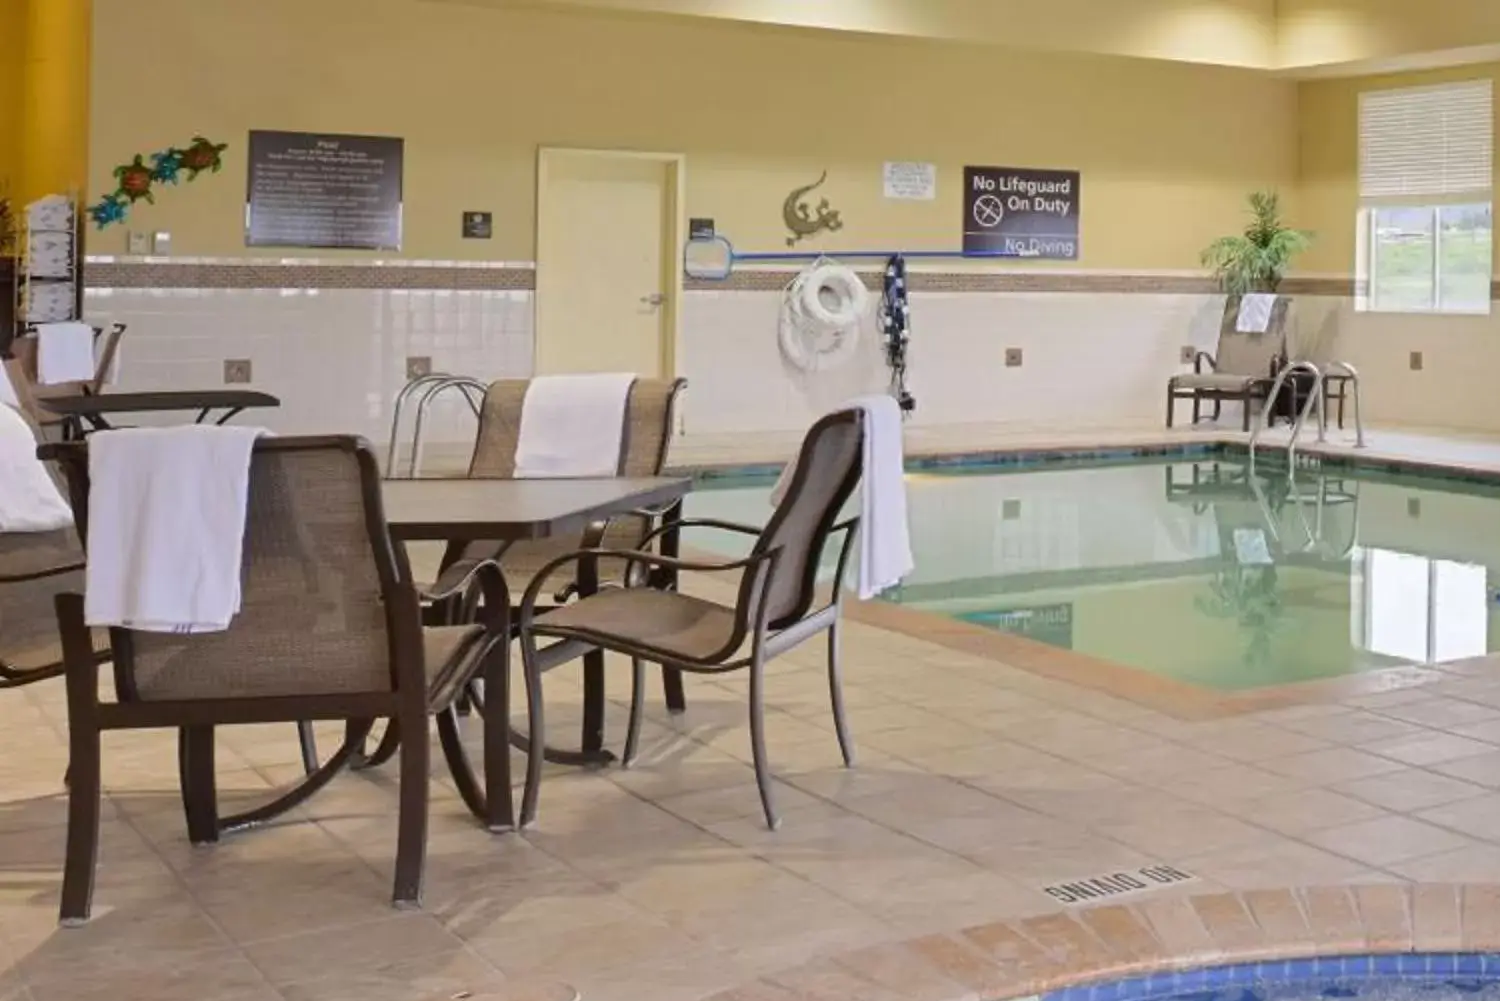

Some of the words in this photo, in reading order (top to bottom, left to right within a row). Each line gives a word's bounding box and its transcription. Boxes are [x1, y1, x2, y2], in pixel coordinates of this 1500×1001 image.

[973, 175, 995, 190] No
[999, 176, 1071, 196] Lifeguard
[1008, 195, 1029, 211] On
[1034, 197, 1070, 217] Duty
[1005, 237, 1025, 254] No
[1029, 238, 1074, 257] Diving
[1139, 865, 1193, 884] NO
[1045, 873, 1147, 903] DIVING
